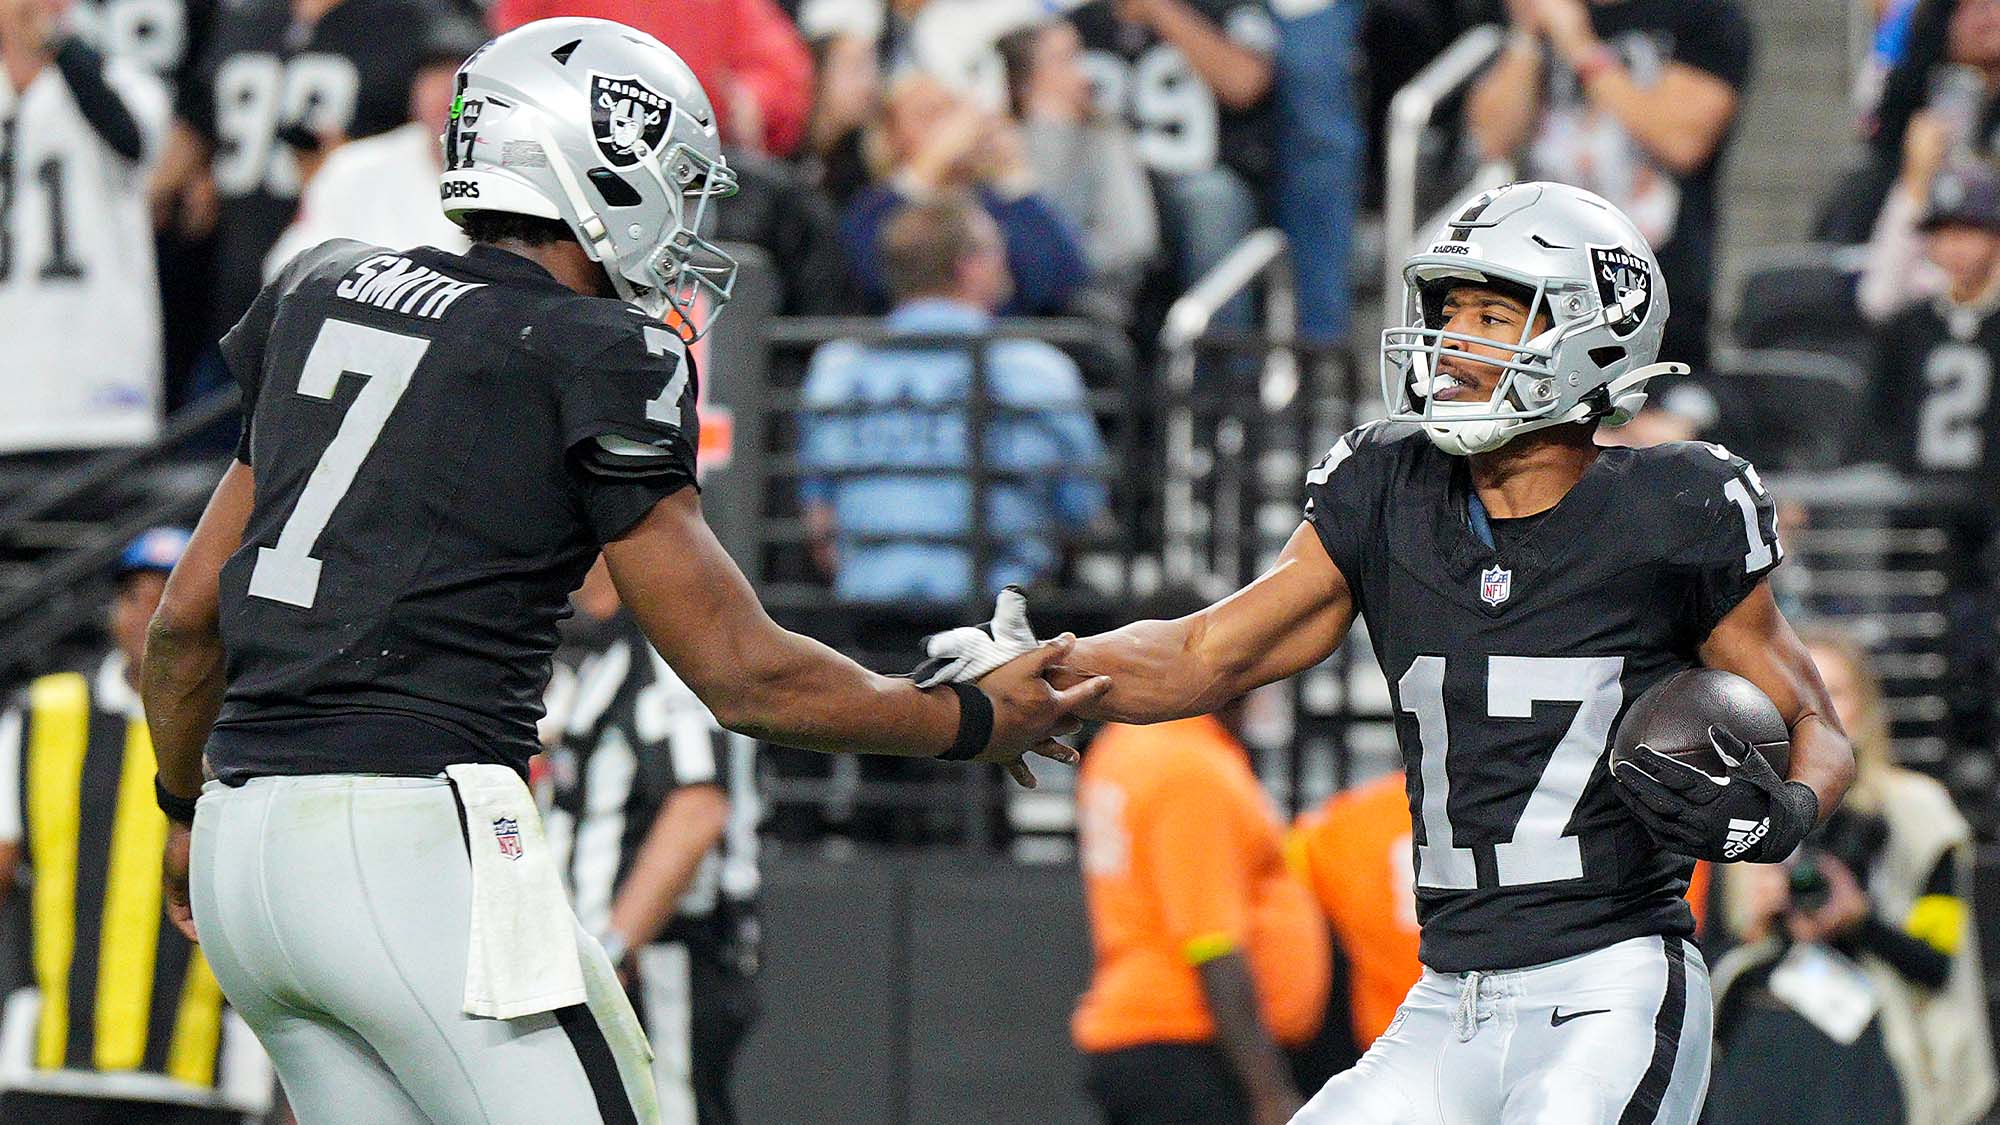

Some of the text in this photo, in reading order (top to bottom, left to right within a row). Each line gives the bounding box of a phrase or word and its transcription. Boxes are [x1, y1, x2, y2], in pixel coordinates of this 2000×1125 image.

[598, 78, 667, 110] RAIDERS
[460, 131, 478, 169] 7
[0, 116, 86, 284] 1
[1433, 245, 1470, 256] RAIDERS
[1597, 250, 1648, 273] RAIDERS
[336, 254, 488, 319] SMITH
[643, 325, 690, 428] 7
[248, 318, 430, 609] 7
[1485, 583, 1505, 599] NFL
[1398, 656, 1625, 889] 17
[1723, 816, 1771, 859] adidas
